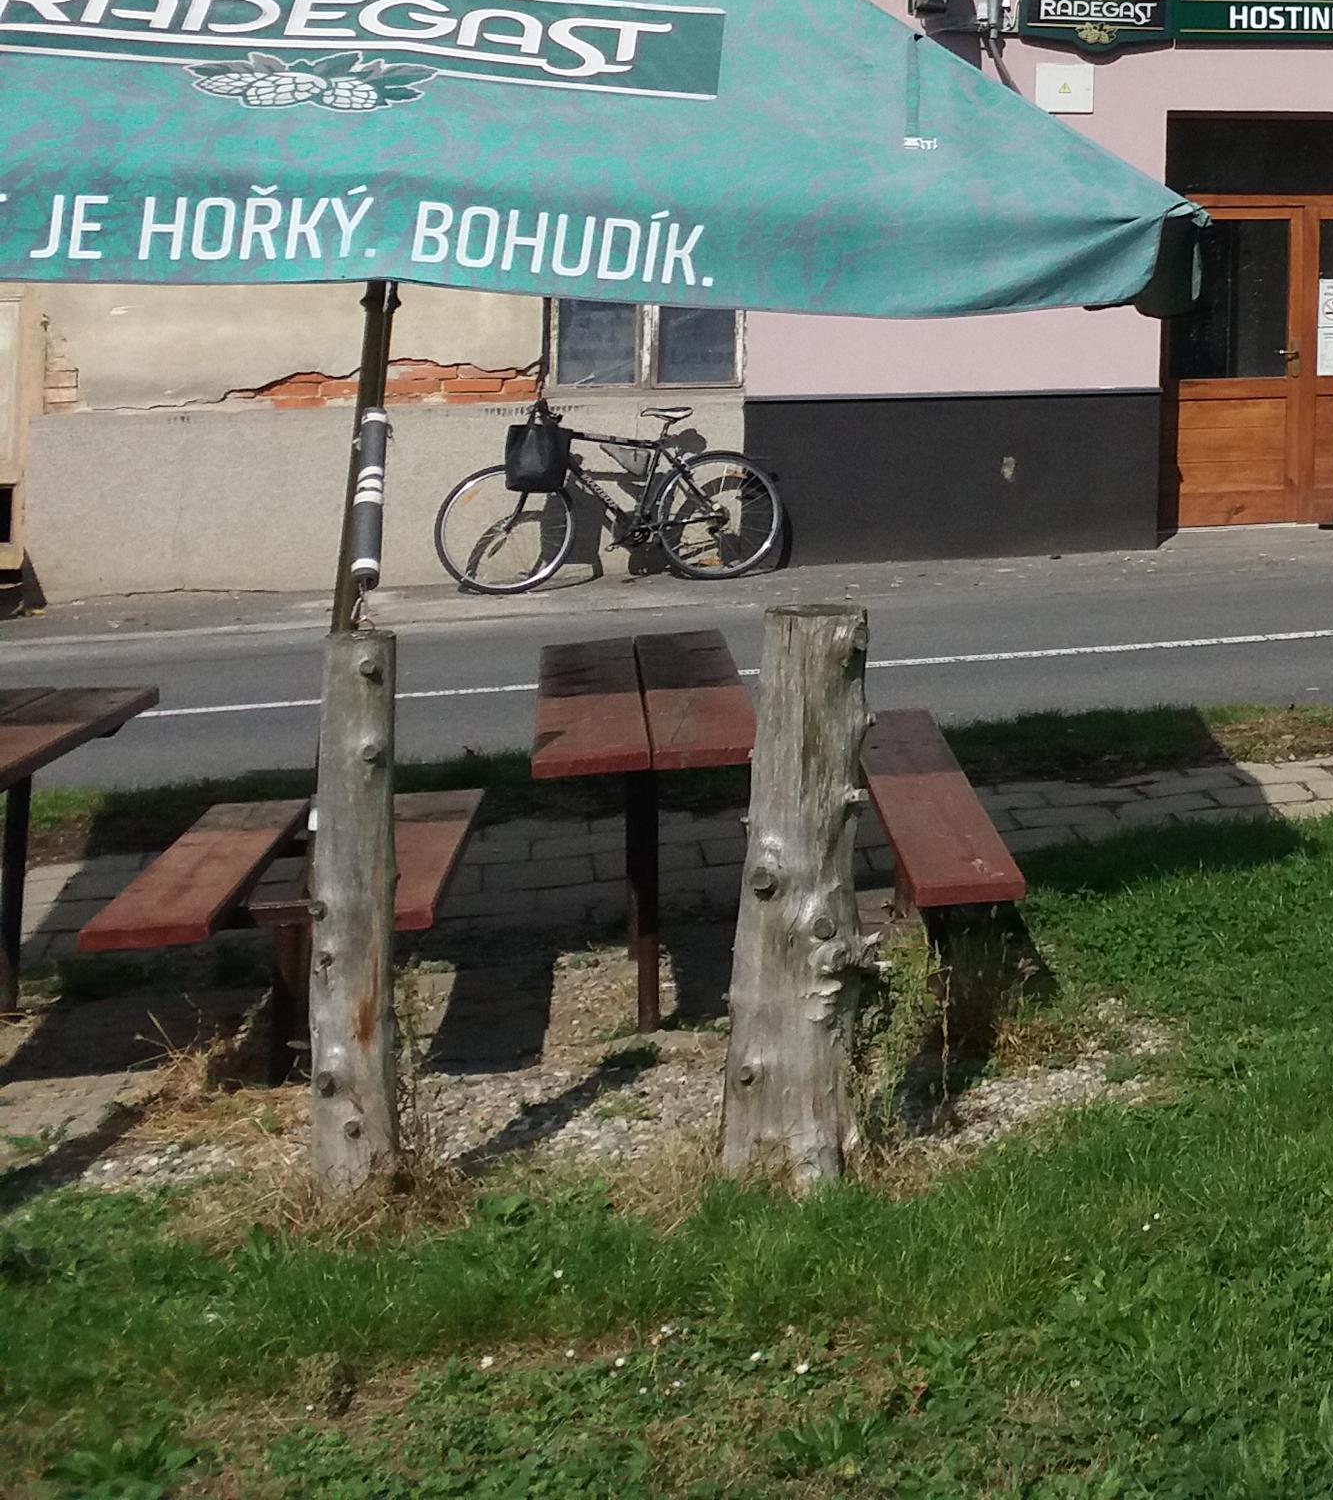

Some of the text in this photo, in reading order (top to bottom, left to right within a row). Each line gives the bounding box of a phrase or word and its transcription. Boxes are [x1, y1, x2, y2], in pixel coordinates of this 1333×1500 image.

[1040, 0, 1158, 25] RADEGAST
[30, 185, 714, 287] JE HOŘKÝ. BOHUDÍK.
